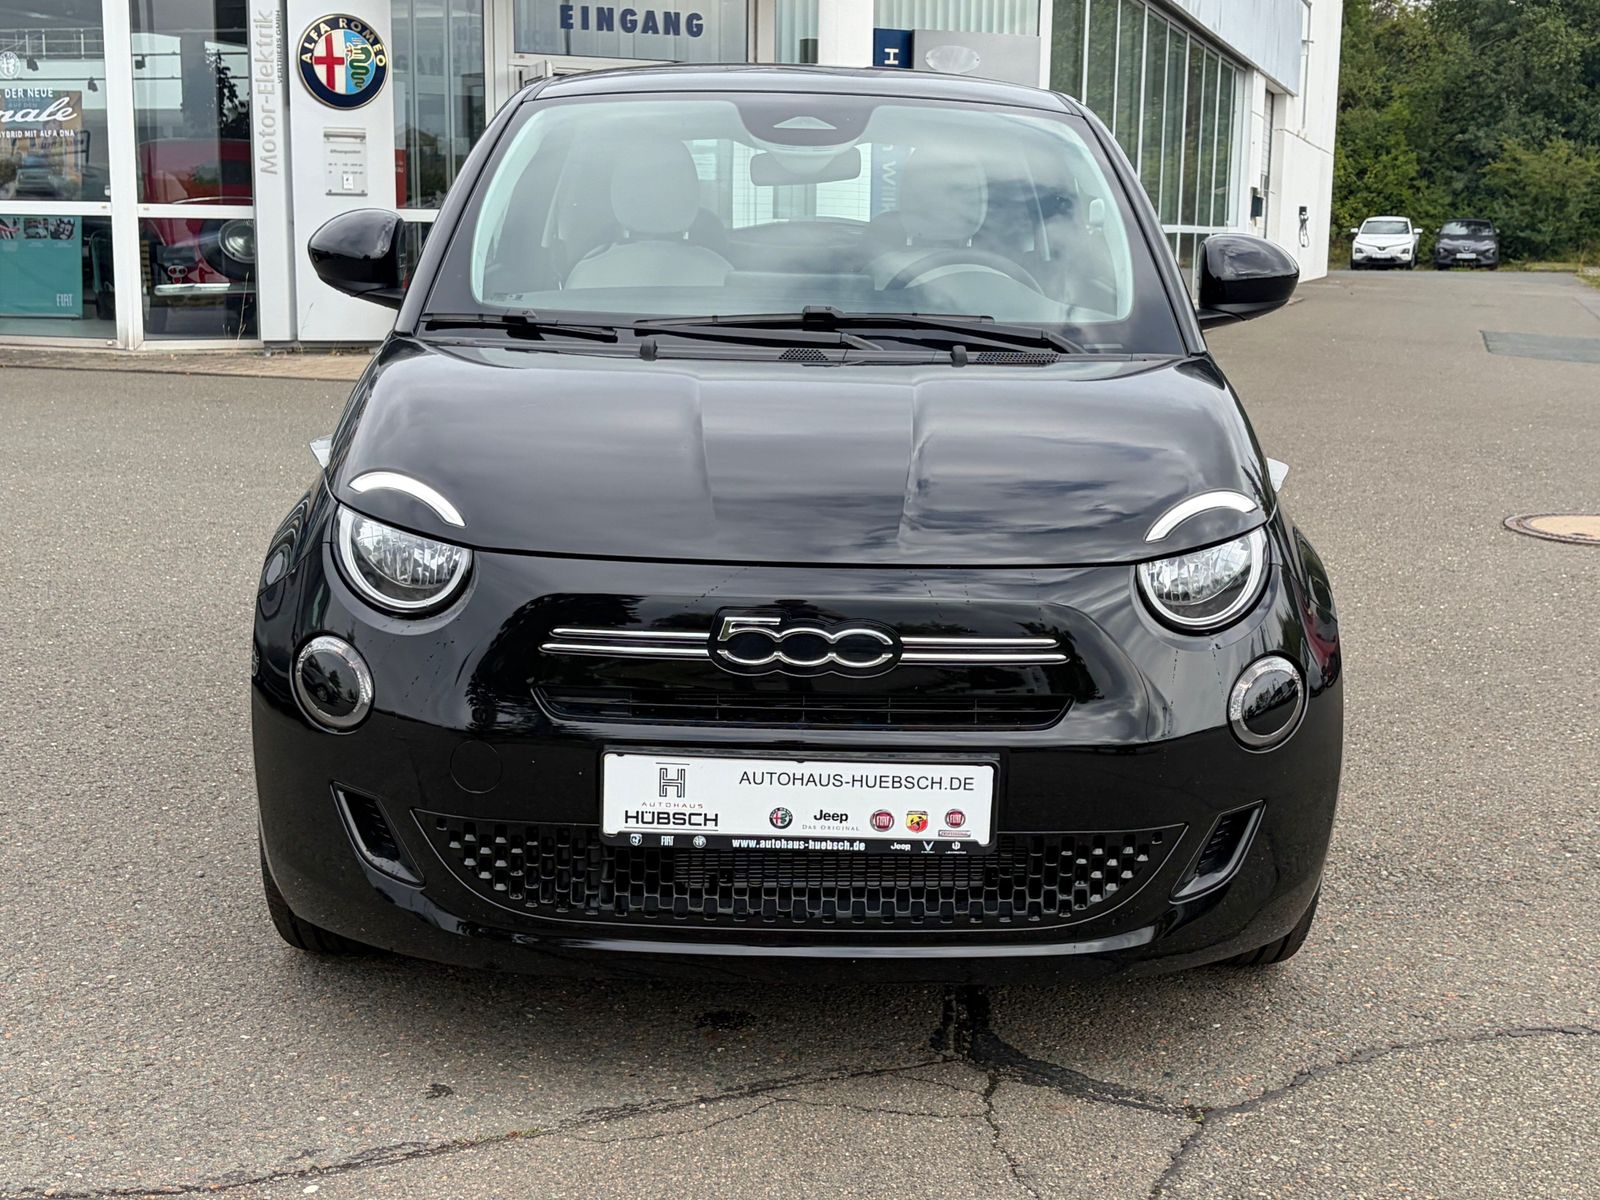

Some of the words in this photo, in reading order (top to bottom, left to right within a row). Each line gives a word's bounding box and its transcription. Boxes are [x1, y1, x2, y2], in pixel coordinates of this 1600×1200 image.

[560, 4, 704, 38] EINGANG
[301, 23, 331, 64] ALFA
[339, 18, 386, 67] ROMEO
[5, 89, 24, 98] DER
[27, 88, 53, 98] NEUE
[253, 9, 278, 175] Motor-Elektrik
[25, 130, 36, 138] MIT
[56, 293, 73, 307] FIAT
[717, 616, 894, 668] 500
[739, 770, 975, 791] AUTOHAUS-HUEBSCH.DE
[641, 801, 704, 809] AUTOHAUS
[624, 810, 719, 827] HÜBSCH
[813, 809, 849, 824] Jeep
[876, 815, 890, 826] FIAT
[731, 838, 866, 851] www.autohaus-huebsch.de
[890, 842, 912, 852] Jeep
